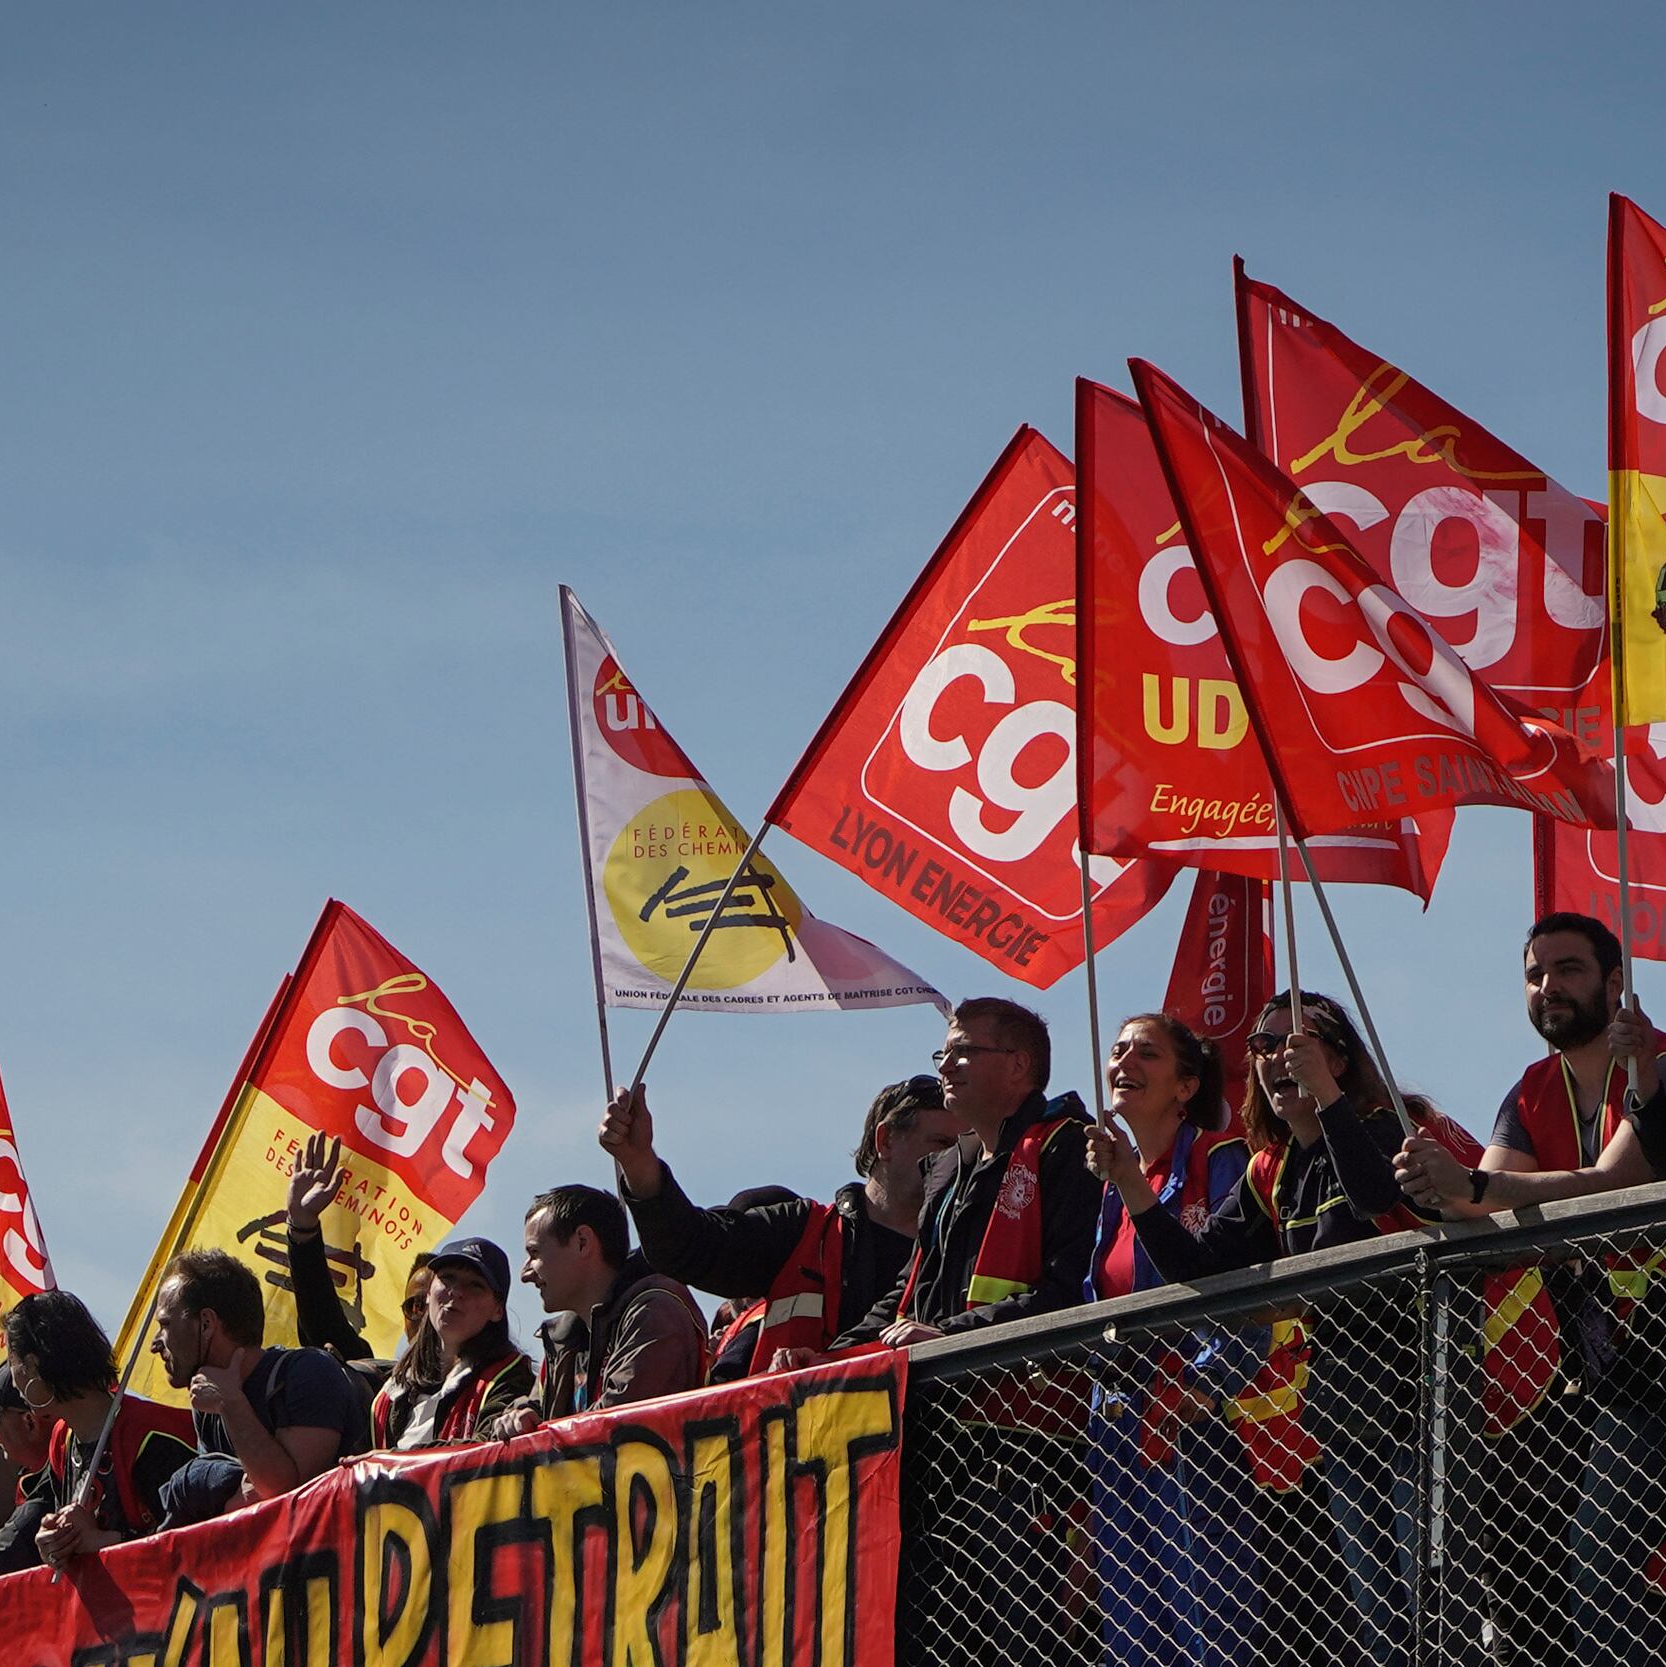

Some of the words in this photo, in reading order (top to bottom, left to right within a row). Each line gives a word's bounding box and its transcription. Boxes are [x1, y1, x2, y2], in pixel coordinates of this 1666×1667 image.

[1290, 362, 1547, 480] la
[1264, 559, 1476, 739] cg
[1142, 672, 1250, 750] UD
[634, 843, 668, 859] DES
[1148, 783, 1277, 837] Engagée,
[829, 806, 920, 888] LYON
[910, 858, 1050, 968] ENERGIE
[615, 989, 647, 999] UNION
[701, 995, 722, 1003] DES
[723, 995, 764, 1004] CADRES
[766, 995, 780, 1004] ET
[782, 993, 825, 1003] AGENTS
[827, 992, 842, 1001] DE
[844, 988, 893, 1000] MAÎTRISE
[895, 986, 915, 995] CGT
[1201, 892, 1236, 1027] énergie
[306, 1007, 495, 1180] cgt
[337, 973, 497, 1107] la
[265, 1146, 294, 1178] DES
[333, 1190, 413, 1251] EMINOTS
[274, 1128, 423, 1236] FÉRATION
